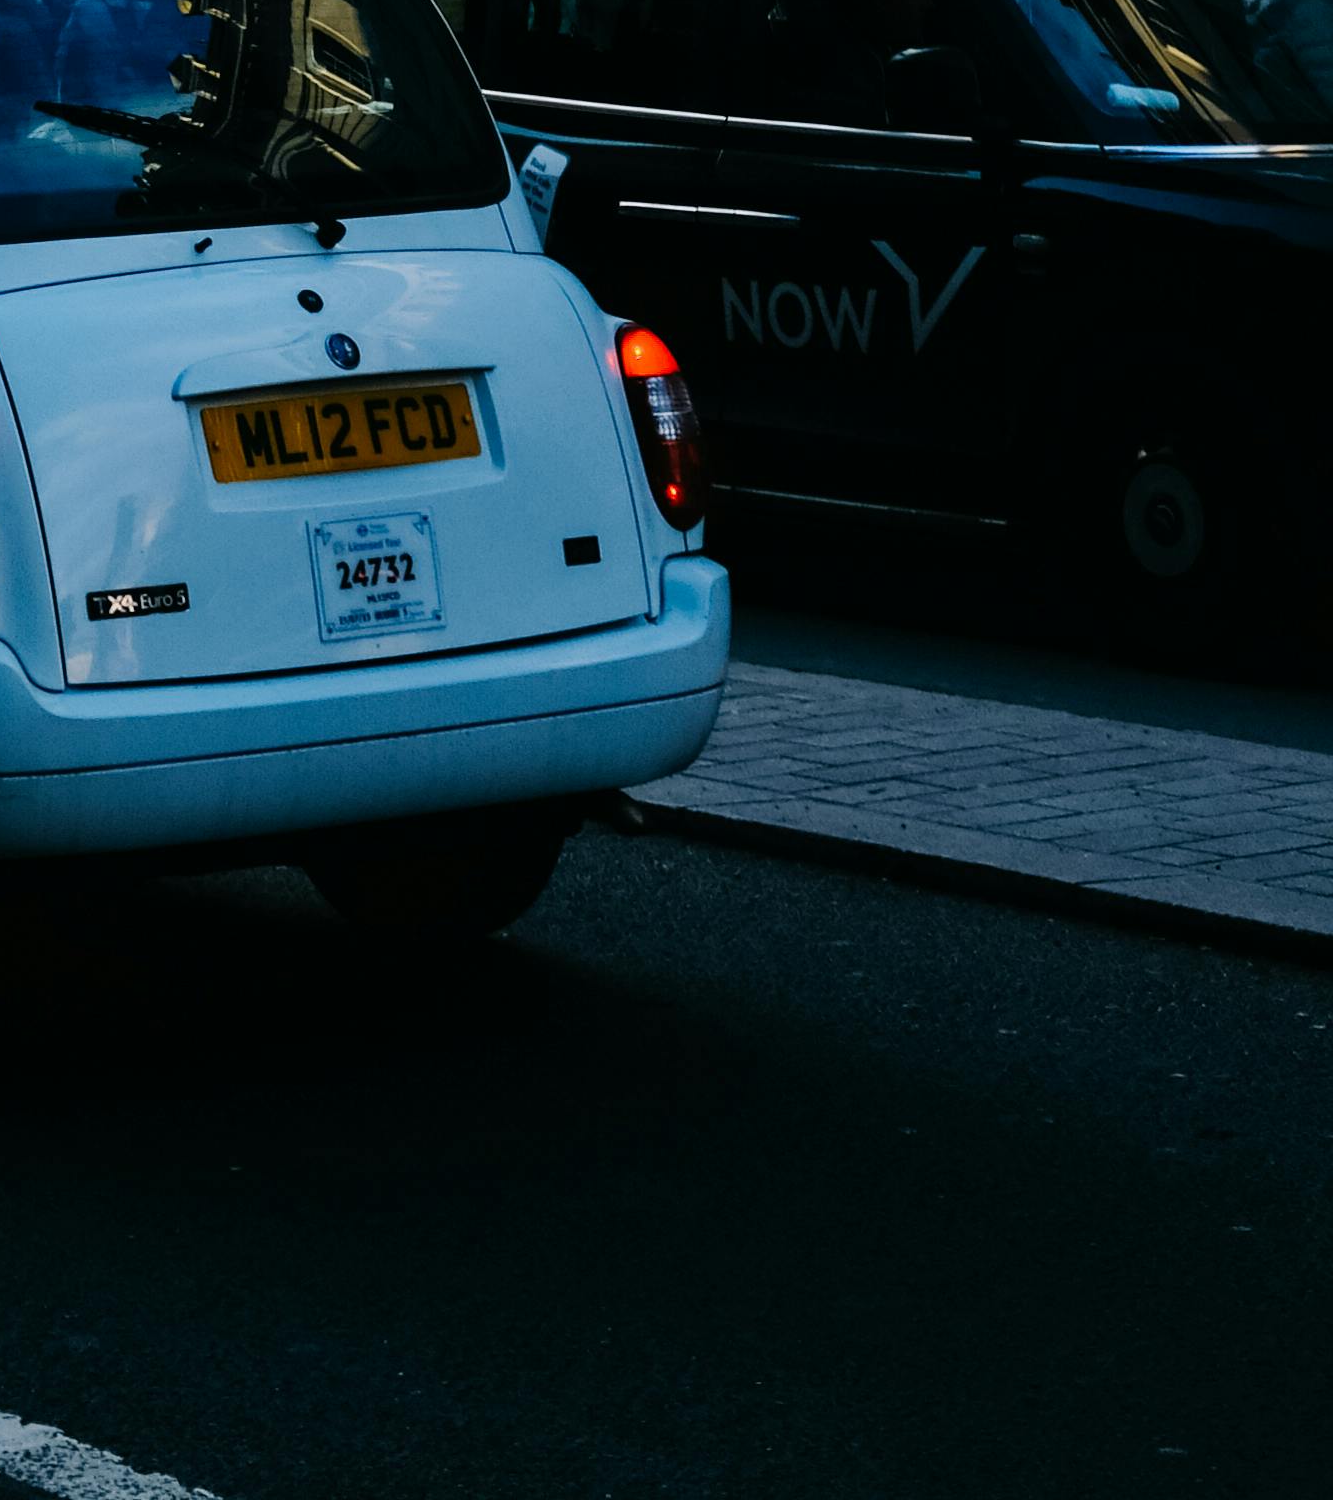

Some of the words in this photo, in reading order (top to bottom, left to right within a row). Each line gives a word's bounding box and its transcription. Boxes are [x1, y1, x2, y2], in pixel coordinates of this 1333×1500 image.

[720, 276, 878, 357] NOW
[235, 402, 358, 468] ML12
[363, 393, 457, 455] FCD
[336, 552, 416, 591] 24732
[92, 593, 139, 615] TX4
[139, 592, 174, 610] Euro
[176, 588, 187, 607] 5
